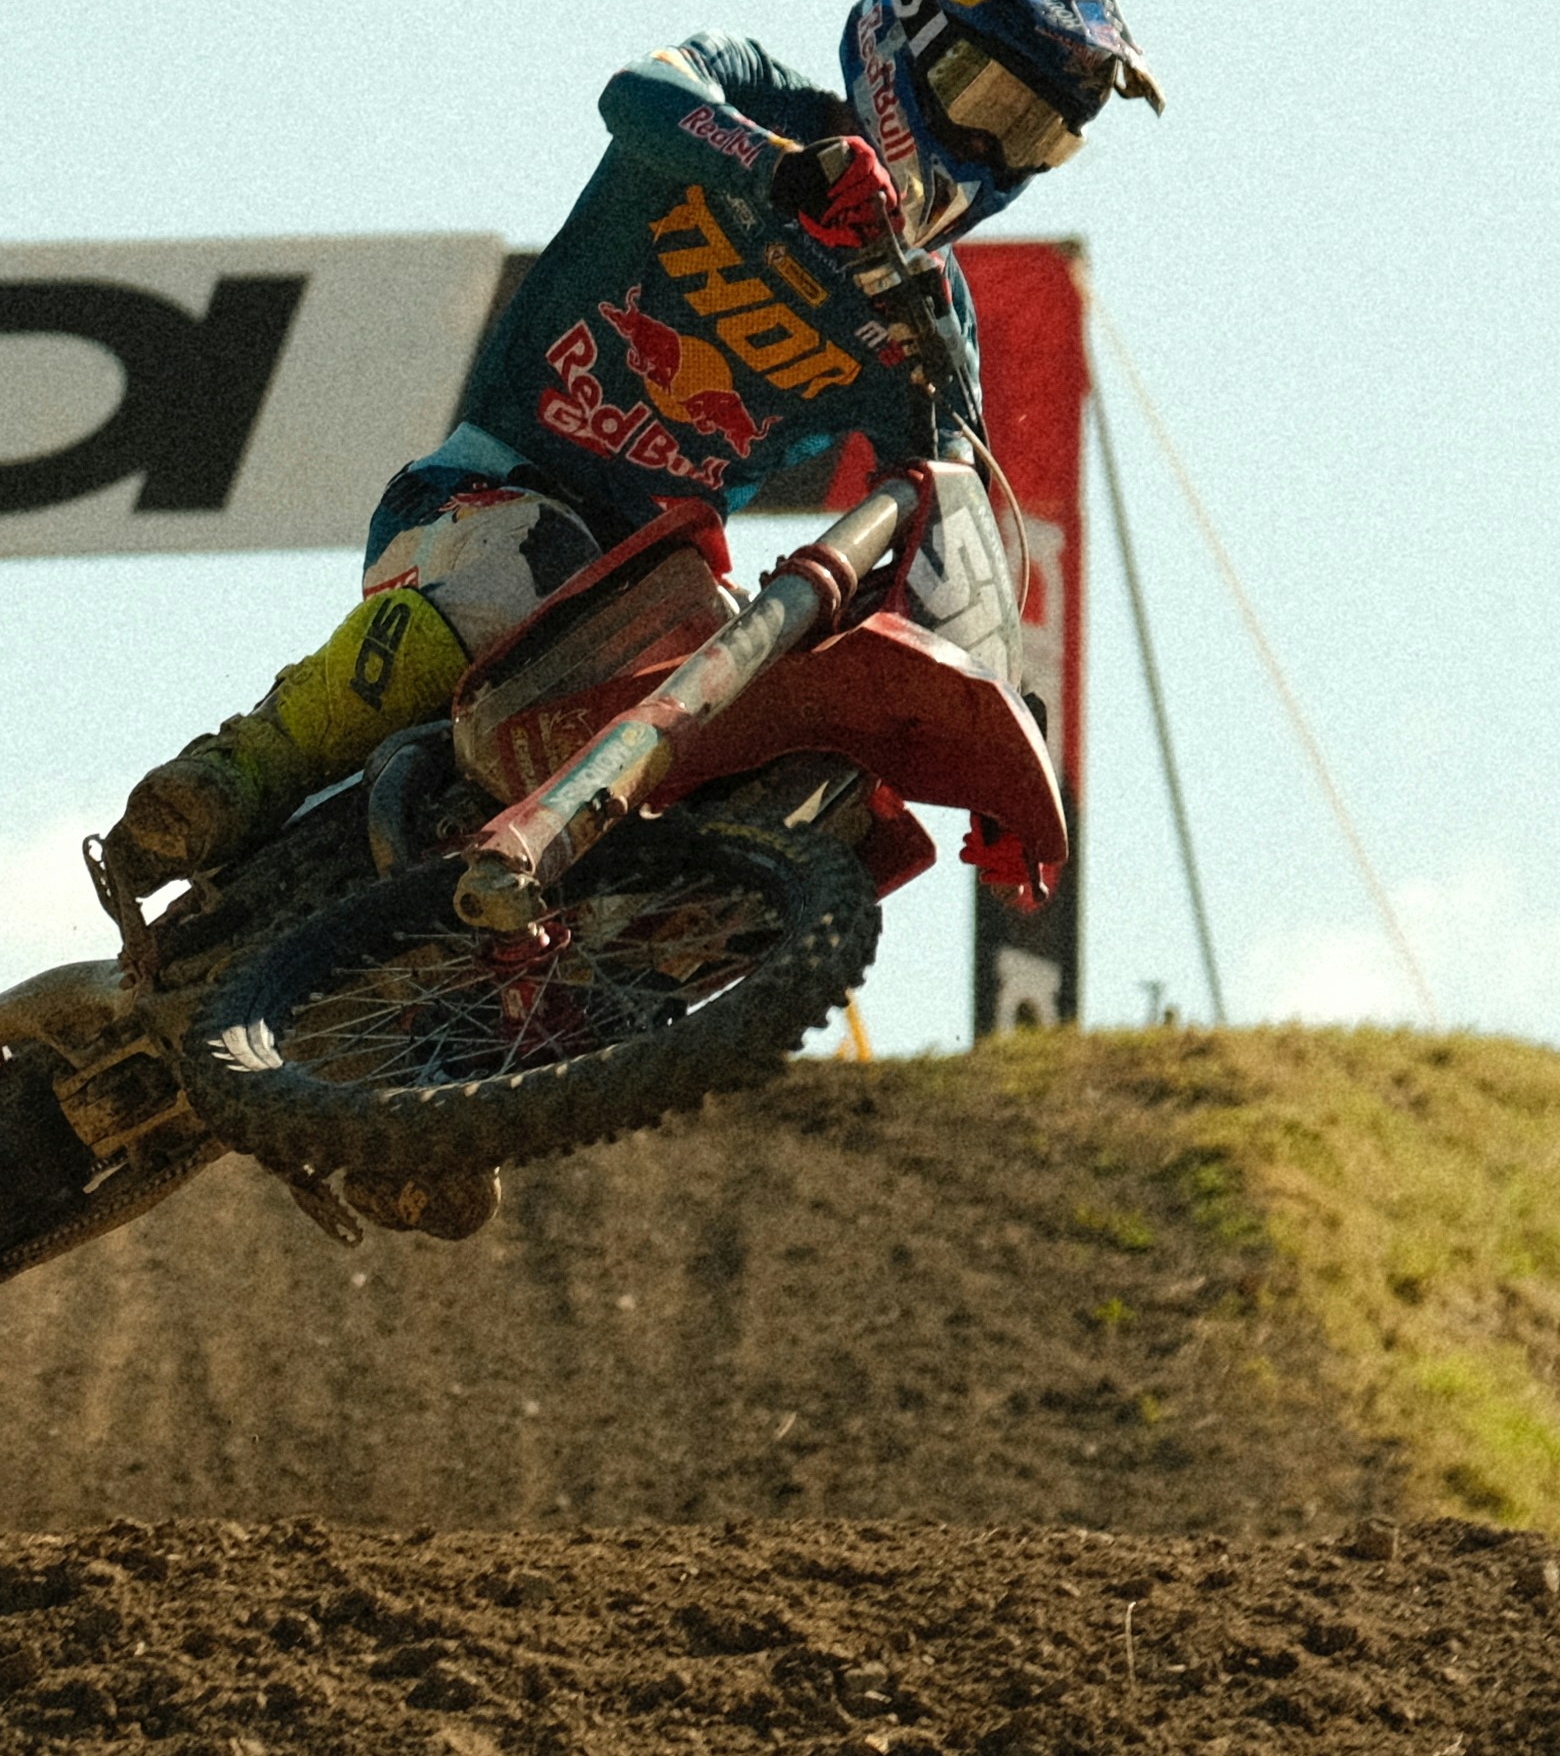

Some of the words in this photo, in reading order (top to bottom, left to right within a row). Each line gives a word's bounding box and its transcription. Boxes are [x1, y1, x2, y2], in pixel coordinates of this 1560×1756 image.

[678, 104, 745, 153] Red
[870, 78, 917, 164] Bull
[649, 184, 862, 400] THOR
[544, 319, 652, 454] Red
